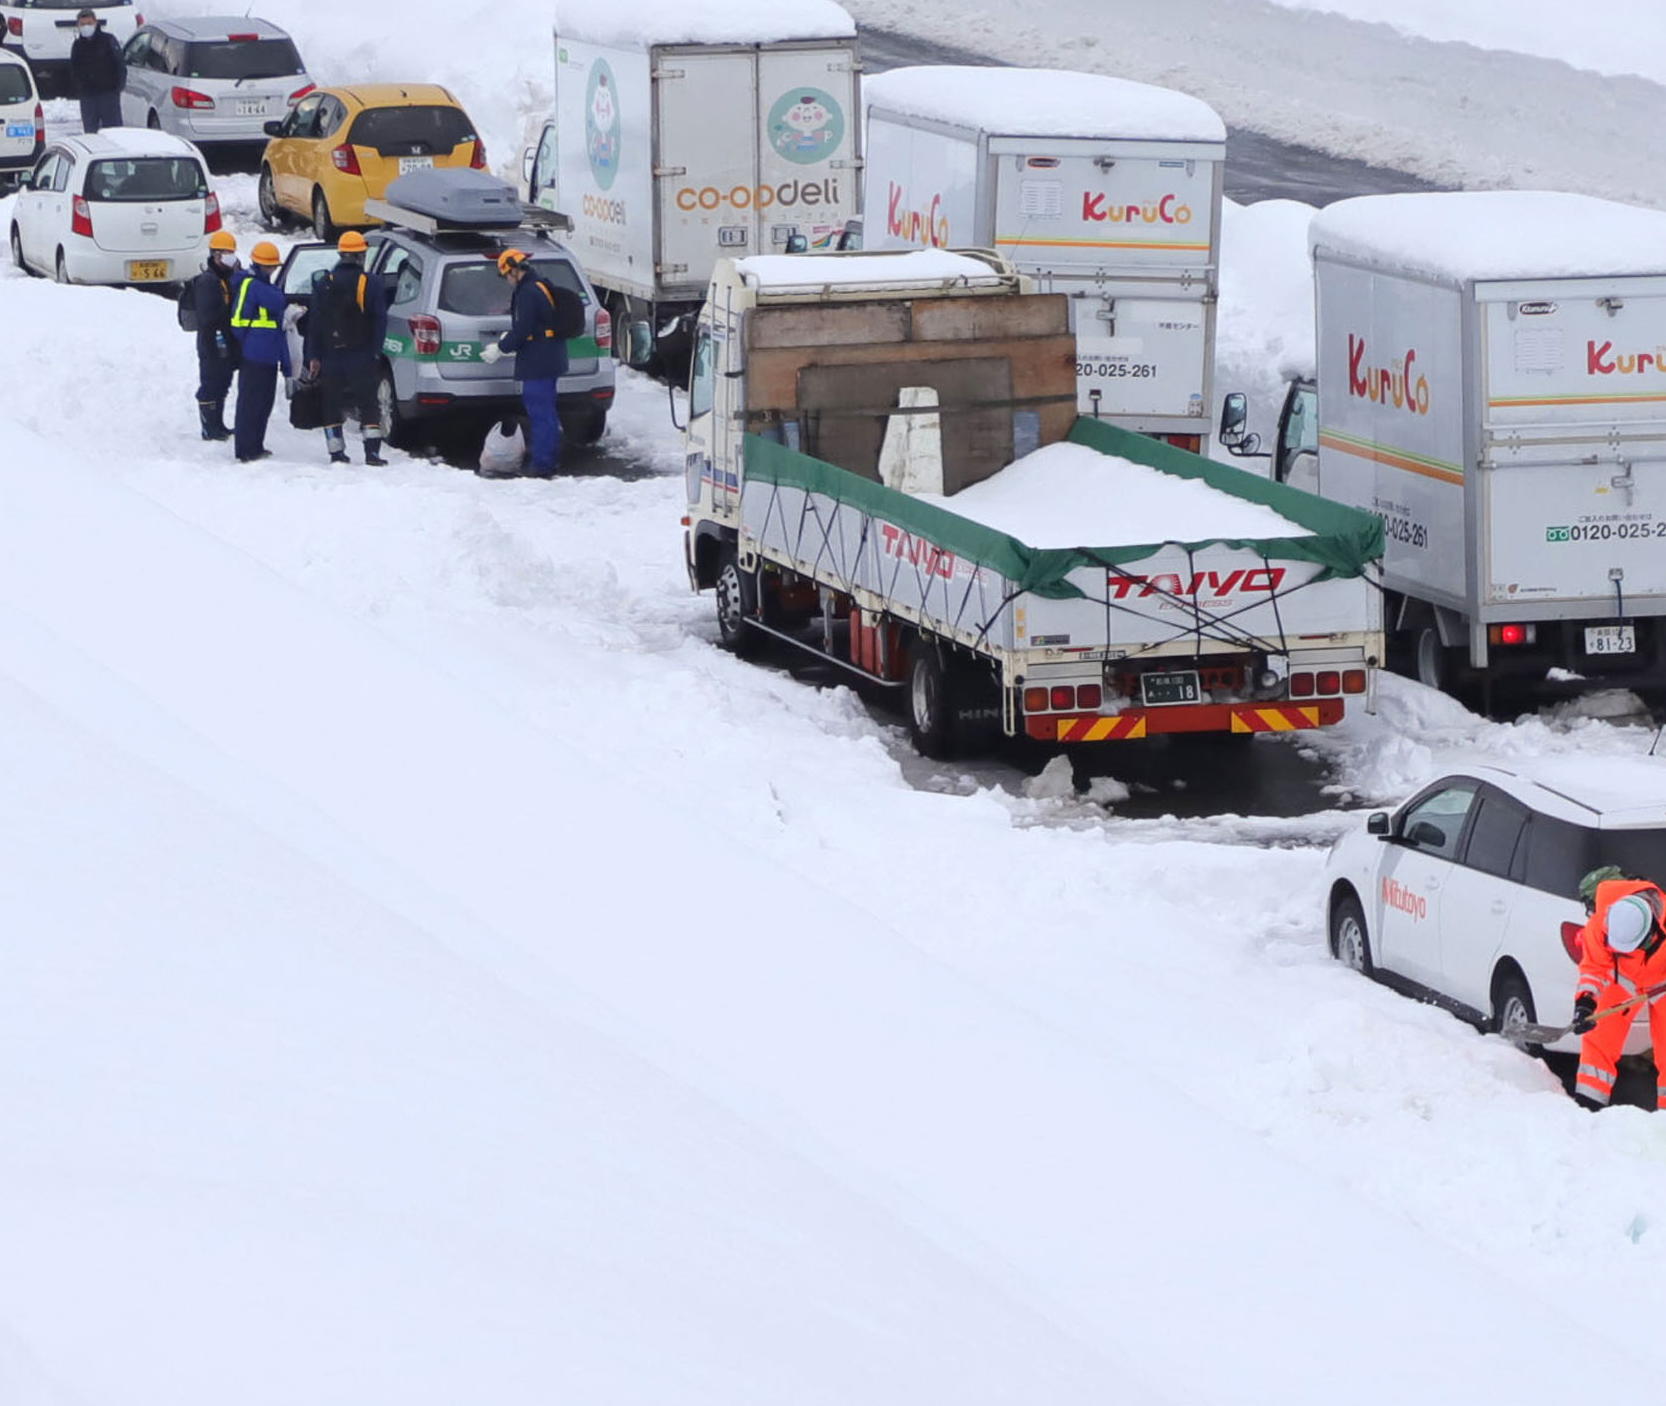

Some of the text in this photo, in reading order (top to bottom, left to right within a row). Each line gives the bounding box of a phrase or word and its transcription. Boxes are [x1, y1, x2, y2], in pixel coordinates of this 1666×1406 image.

[583, 194, 626, 225] co-opdeli
[677, 179, 839, 211] co-opdeli
[1083, 191, 1191, 224] KuruCo
[449, 343, 472, 356] JR
[1076, 363, 1157, 378] 20-025-261
[1349, 334, 1429, 415] KuruCo
[1109, 568, 1286, 599] TAIYO
[1597, 636, 1632, 651] 81-23
[958, 709, 1000, 720] HIN
[1381, 875, 1426, 922] Mitutoyo
